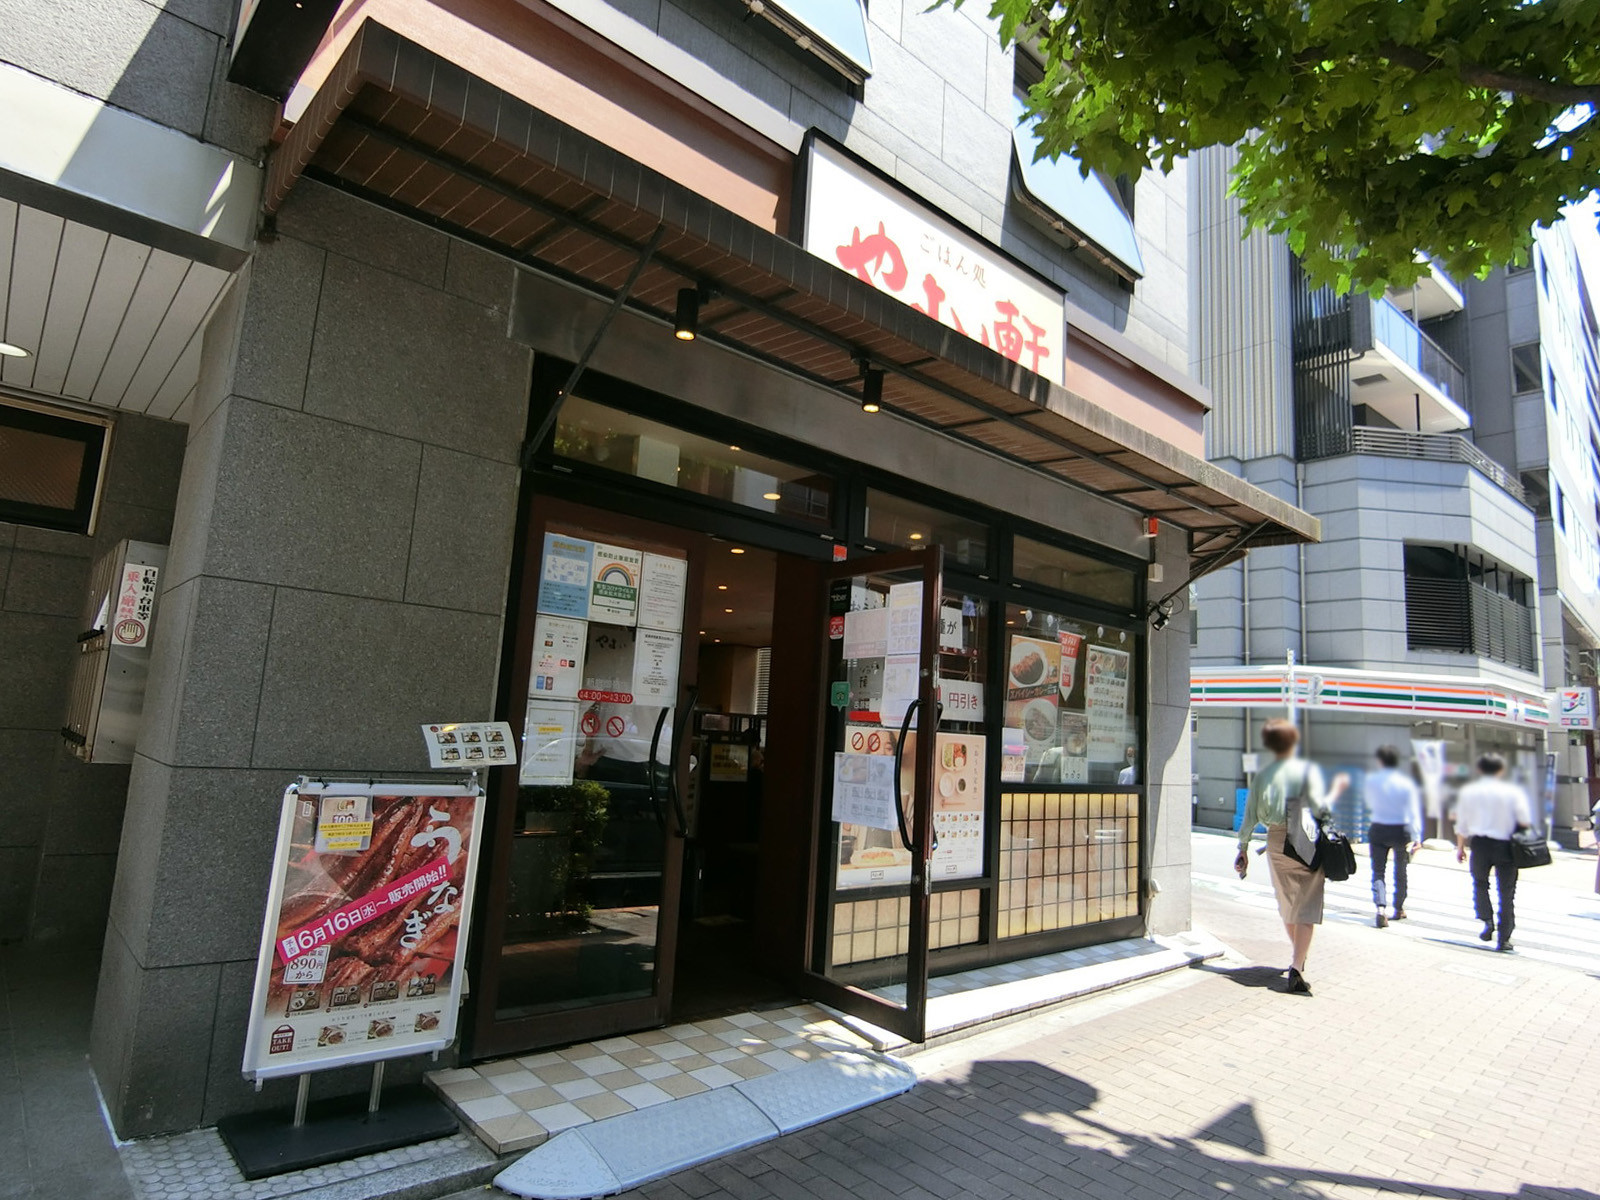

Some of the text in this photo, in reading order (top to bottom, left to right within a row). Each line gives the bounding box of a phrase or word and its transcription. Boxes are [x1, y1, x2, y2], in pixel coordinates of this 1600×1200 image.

[919, 233, 987, 289] ごはん処
[948, 692, 978, 710] 円引き
[400, 805, 462, 949] うなぎ
[295, 970, 314, 980] から
